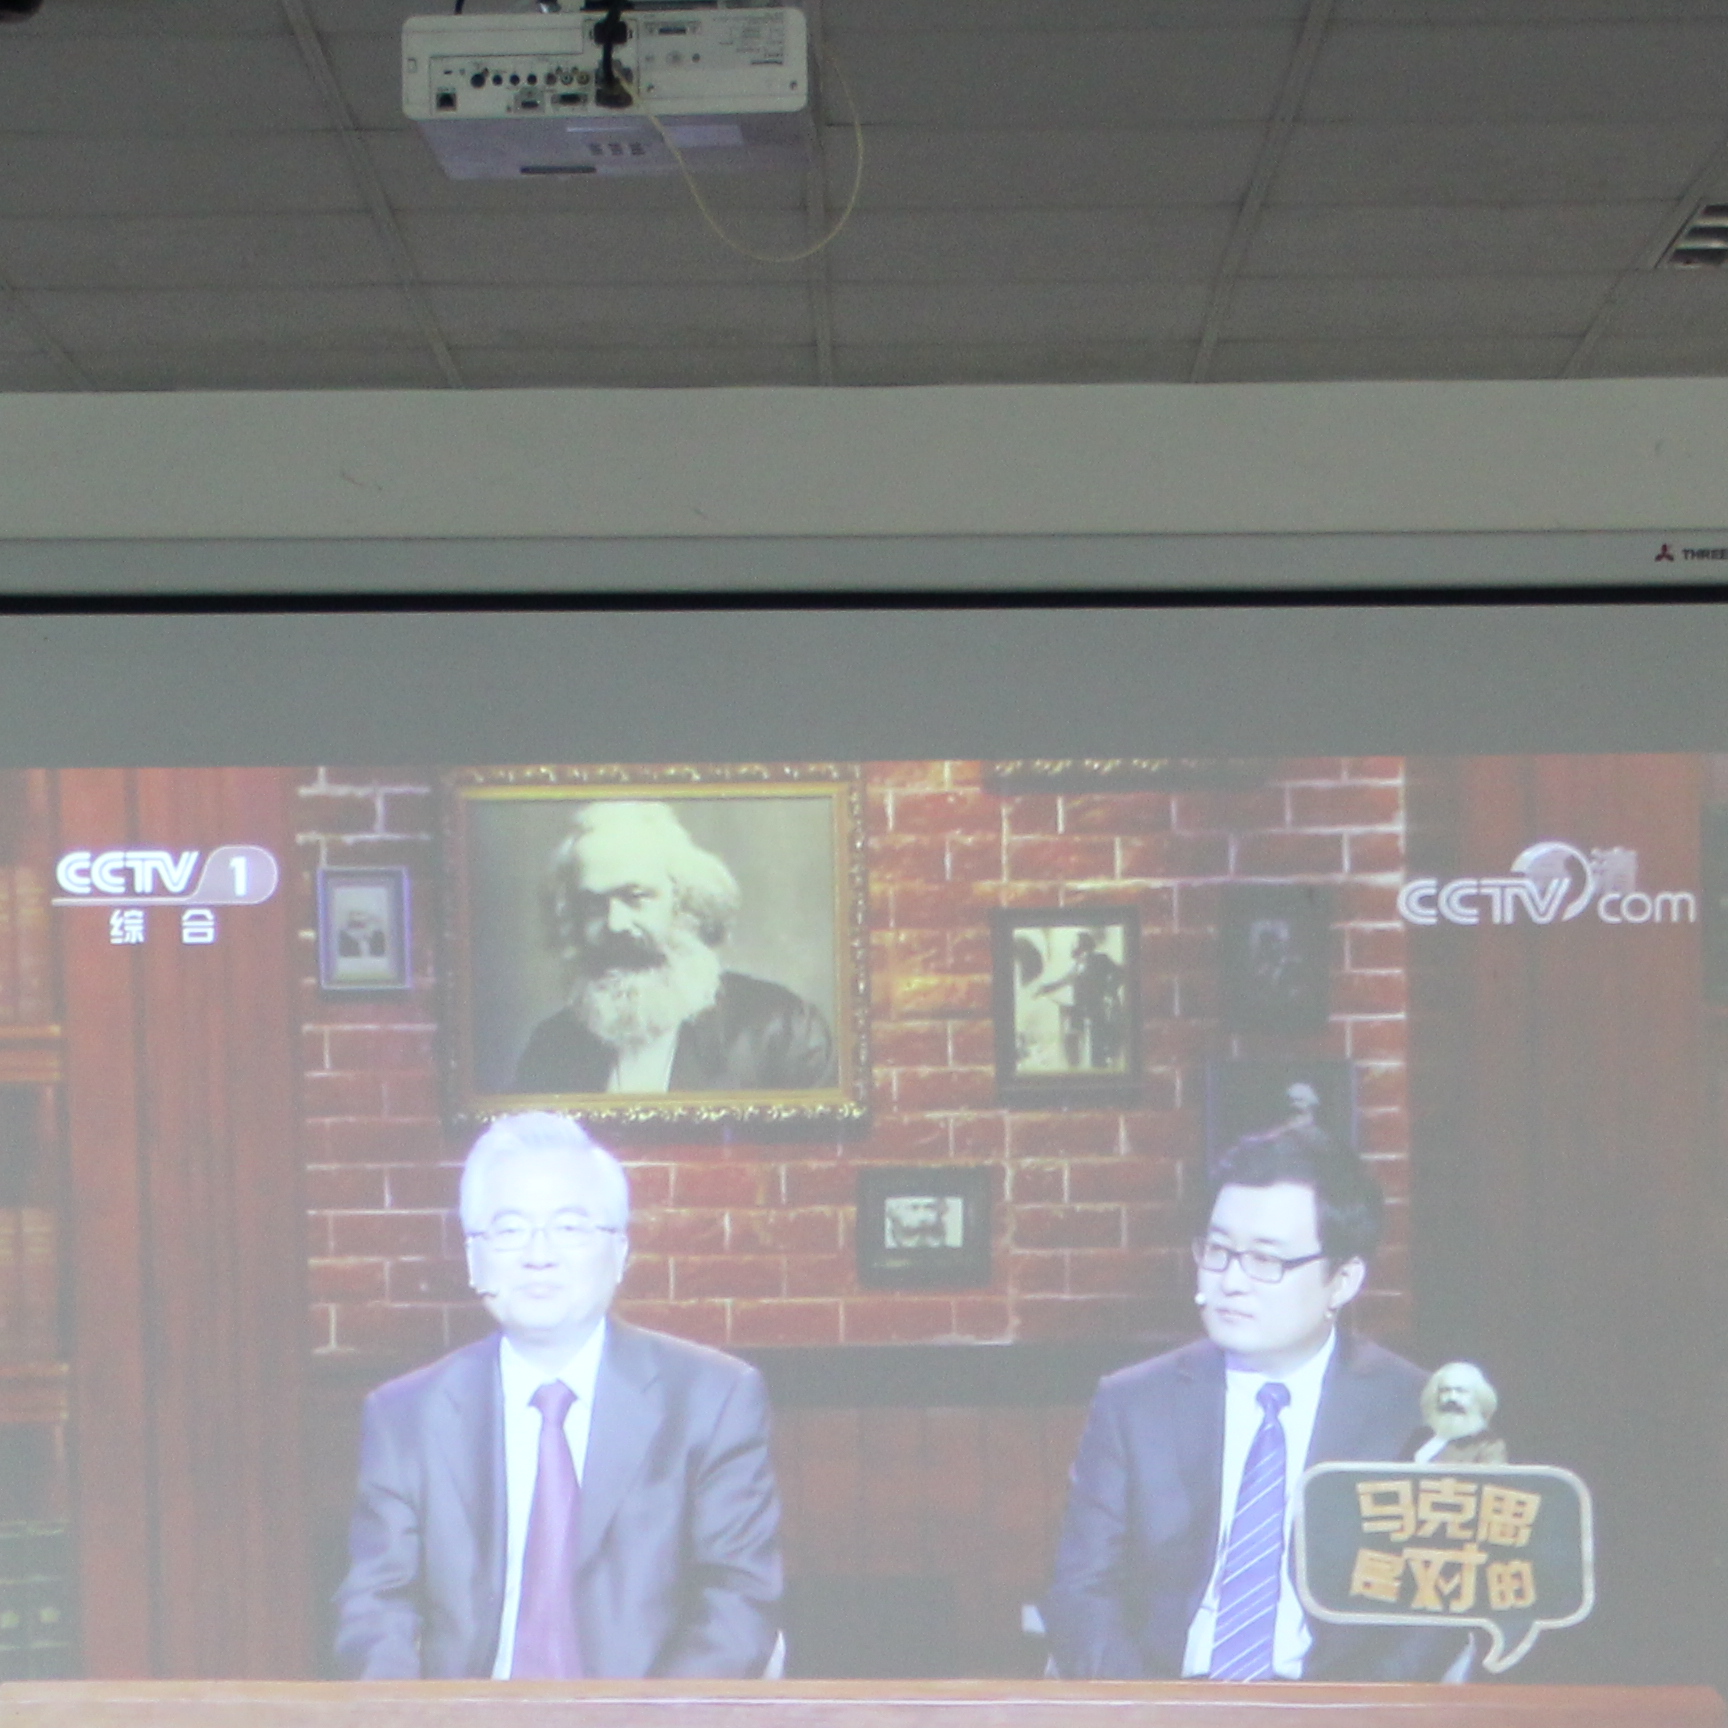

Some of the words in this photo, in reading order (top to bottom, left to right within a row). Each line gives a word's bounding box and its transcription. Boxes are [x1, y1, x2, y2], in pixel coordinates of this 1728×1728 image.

[55, 851, 199, 894] CCTV
[228, 855, 249, 897] 1
[109, 908, 216, 945] 综合
[1355, 1477, 1542, 1548] 马克思
[1348, 1542, 1537, 1613] 是对的
